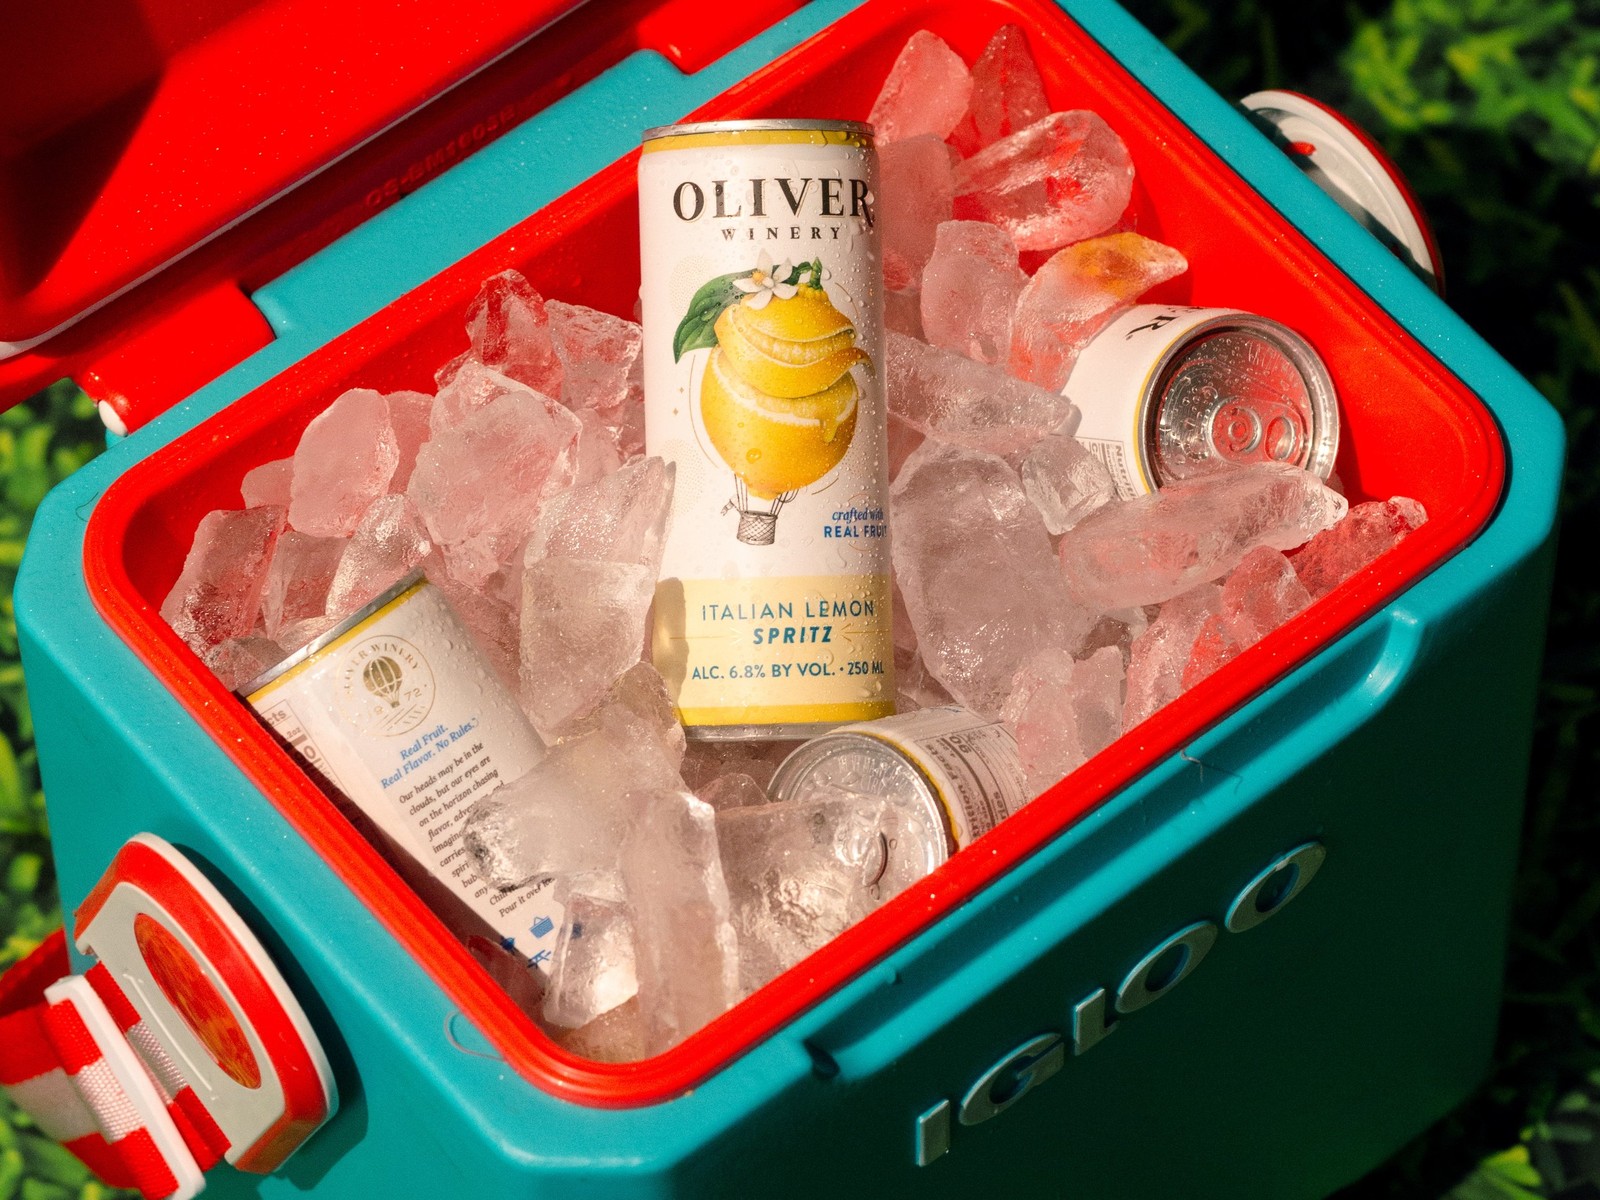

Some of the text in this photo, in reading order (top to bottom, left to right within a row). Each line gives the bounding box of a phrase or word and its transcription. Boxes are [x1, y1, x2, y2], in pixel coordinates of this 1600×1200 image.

[672, 178, 875, 227] OLIVER
[722, 226, 841, 241] WINERY
[832, 506, 884, 524] crafted with
[823, 525, 888, 538] REAL FRUIT
[702, 600, 875, 621] ITALIAN LEMON
[753, 626, 833, 644] SPRITZ
[691, 661, 885, 680] ALC. 6.8% BY VOL. 250 ML
[404, 688, 422, 701] 72
[400, 724, 449, 760] Real Fruit.
[380, 768, 403, 789] Real
[403, 750, 436, 775] Flavor.
[435, 739, 450, 753] No
[399, 742, 484, 804] Our heads may be in the
[409, 756, 491, 816] clouds, but our eyes are
[418, 768, 499, 828] on the horizon chasing
[427, 820, 454, 842] flavor,
[439, 846, 466, 867] carries
[451, 861, 469, 878] spiri
[499, 899, 518, 917] Pour
[518, 894, 526, 904] it
[526, 885, 542, 899] over
[916, 841, 1327, 1167] IGLOO
